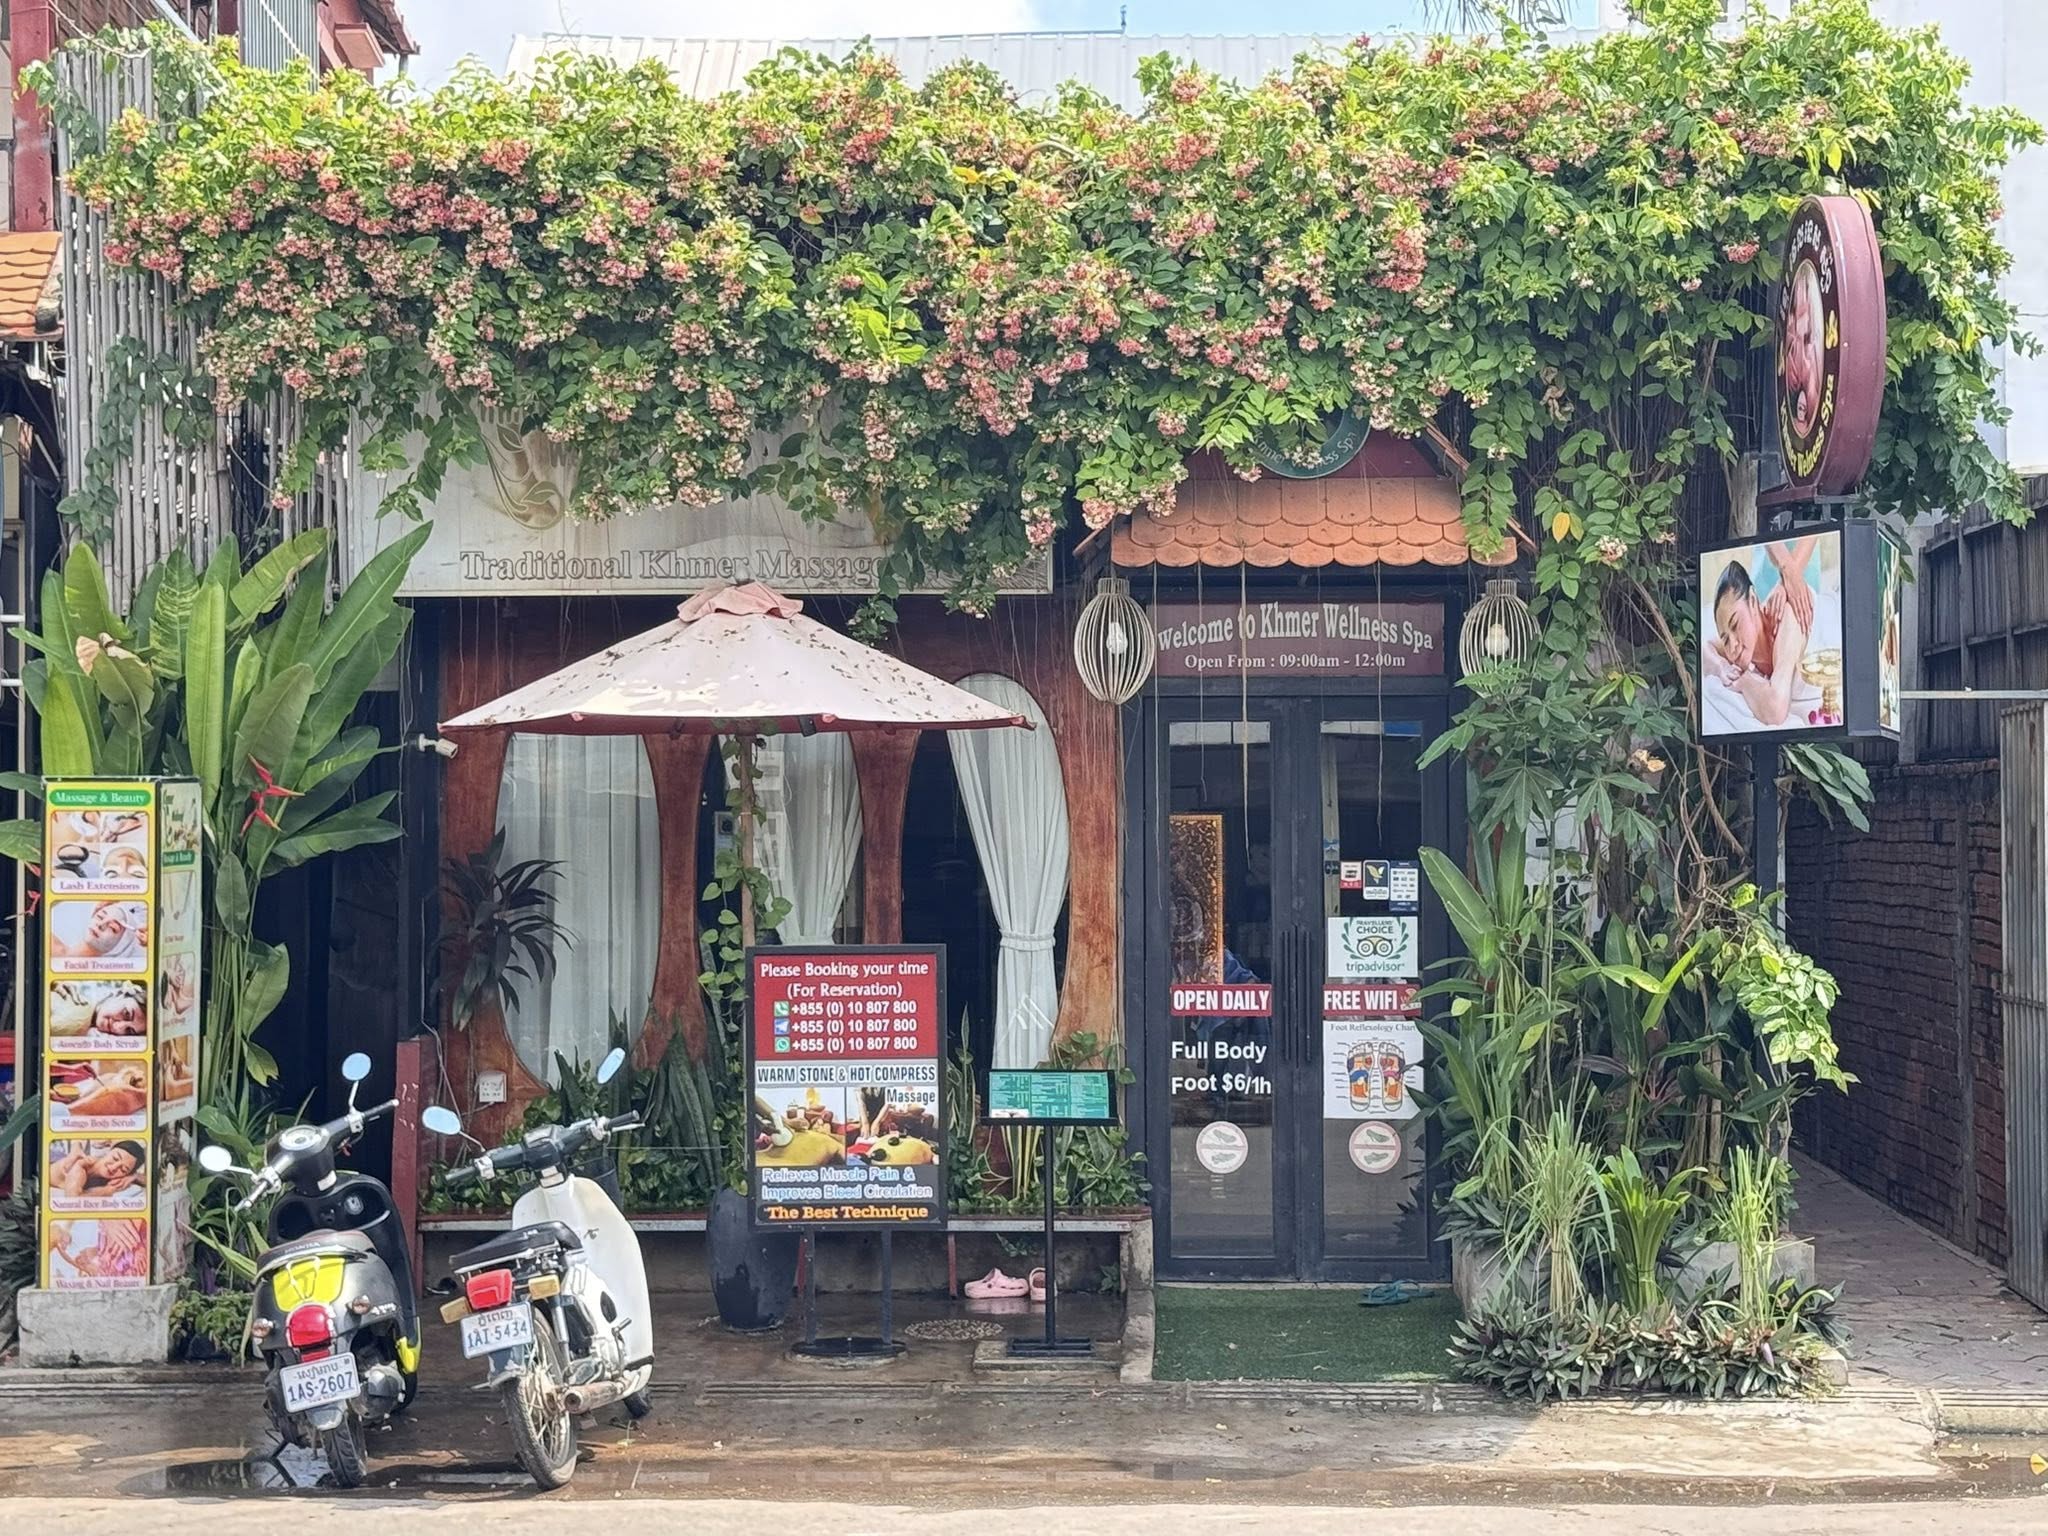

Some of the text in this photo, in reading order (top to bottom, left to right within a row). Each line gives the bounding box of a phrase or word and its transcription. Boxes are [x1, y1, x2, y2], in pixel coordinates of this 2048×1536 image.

[459, 550, 632, 580] Traditional
[639, 550, 750, 580] Khmer
[1158, 601, 1434, 654] Welcome to Khmer Wellness Spa
[1184, 654, 1223, 672] Open
[1227, 654, 1266, 668] From
[1279, 653, 1340, 668] 09:00am
[1354, 653, 1406, 667] 12:00m
[55, 791, 146, 805] Massage & Beauty
[60, 881, 141, 890] Lash Extensions
[1356, 926, 1394, 934] CHOICE
[64, 961, 134, 970] Facial Treatment
[760, 961, 929, 979] Please Booking your time
[1346, 961, 1402, 974] tripadvisor
[786, 981, 903, 1000] (For Reservation)
[1173, 990, 1270, 1010] OPEN DAILY
[1323, 990, 1361, 1011] FREE
[1364, 989, 1398, 1011] WIFI
[791, 1001, 917, 1018] +855 (0) 10 807 800
[791, 1019, 917, 1036] +855 (0) 10 807 800
[1330, 1023, 1348, 1031] Foot
[1349, 1023, 1394, 1033] Reflexology
[94, 1040, 112, 1050] Body
[115, 1040, 140, 1048] Scrub
[792, 1037, 918, 1054] +855 (0) 10 807 800
[1171, 1041, 1267, 1064] Full Body
[757, 1066, 936, 1083] WARM STONE & HOT COMPRESS
[1171, 1072, 1272, 1095] Foot $6/1h
[886, 1088, 936, 1105] Massage
[62, 1119, 136, 1128] Mango Body Scrub
[761, 1166, 916, 1183] Relieves Muscle Pain &
[761, 1184, 934, 1202] Improves Blood Circulation
[121, 1200, 145, 1208] Scrub
[802, 1205, 839, 1219] Best
[840, 1204, 929, 1221] Technique
[288, 1371, 354, 1403] 1AS-2607
